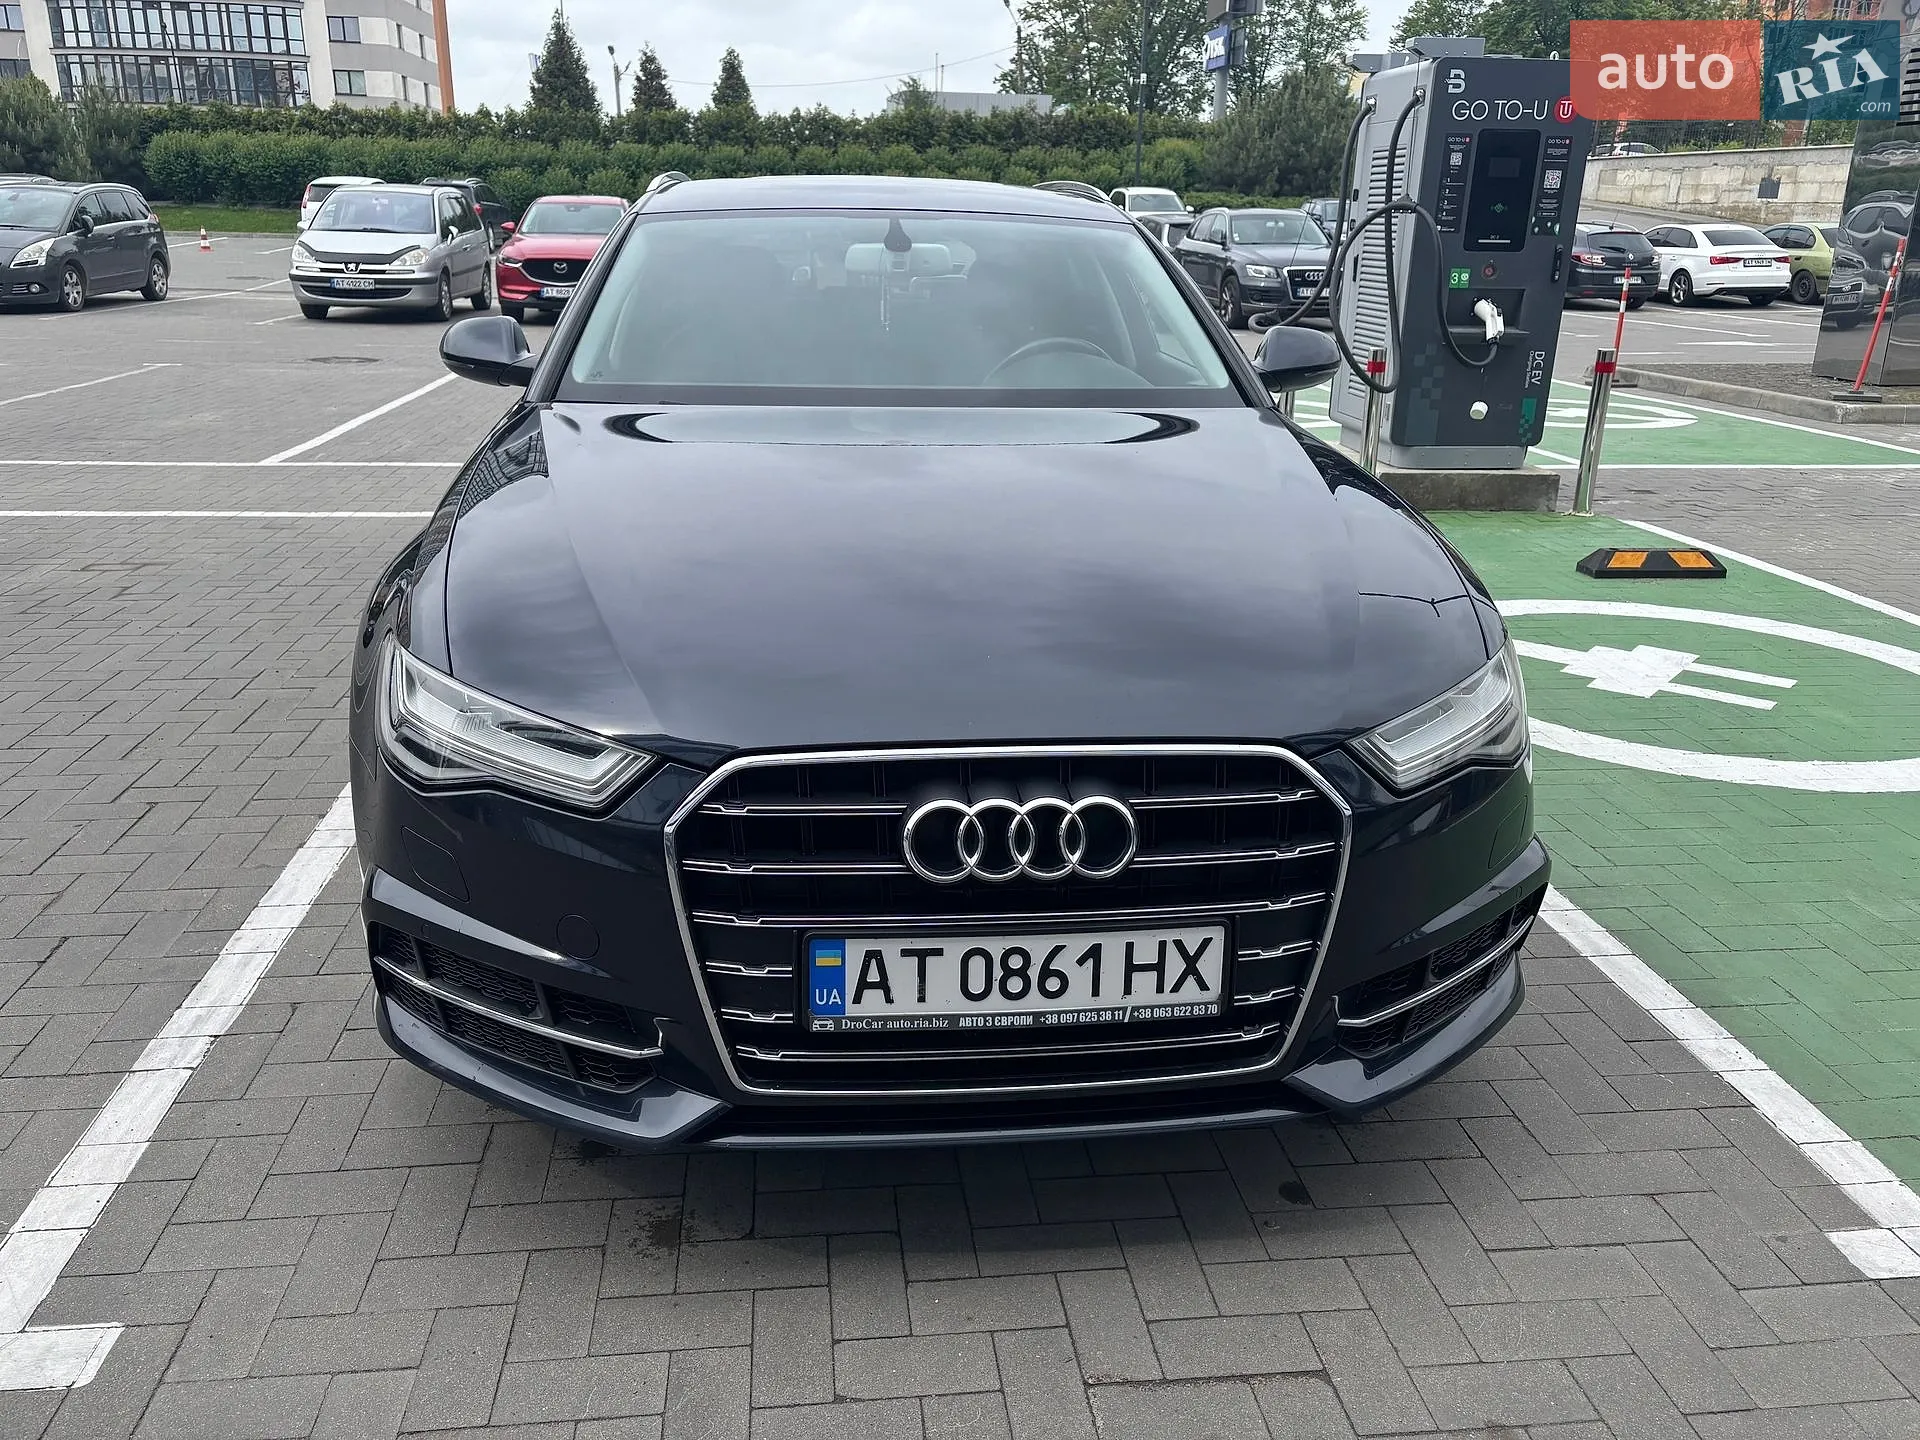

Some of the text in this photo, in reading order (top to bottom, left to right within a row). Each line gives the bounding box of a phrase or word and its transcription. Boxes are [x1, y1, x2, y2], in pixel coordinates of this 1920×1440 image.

[1451, 99, 1489, 120] GO
[1494, 99, 1549, 120] TO-U
[1450, 272, 1459, 284] 3
[1531, 351, 1546, 385] DC EV
[815, 937, 1214, 1005] UA AT 0861 HX
[841, 1018, 950, 1030] DroCar auto.ria.biz
[959, 1016, 984, 1028] АВТО
[1039, 1013, 1058, 1024] +38
[1060, 1012, 1079, 1023] 097
[1079, 1011, 1098, 1022] 625
[1099, 1010, 1114, 1021] 38
[1114, 1010, 1123, 1020] 11
[1133, 1008, 1151, 1019] +38
[1153, 1006, 1172, 1018] 063
[1173, 1005, 1192, 1017] 622
[1193, 1004, 1206, 1015] 83
[1207, 1004, 1218, 1015] 70
